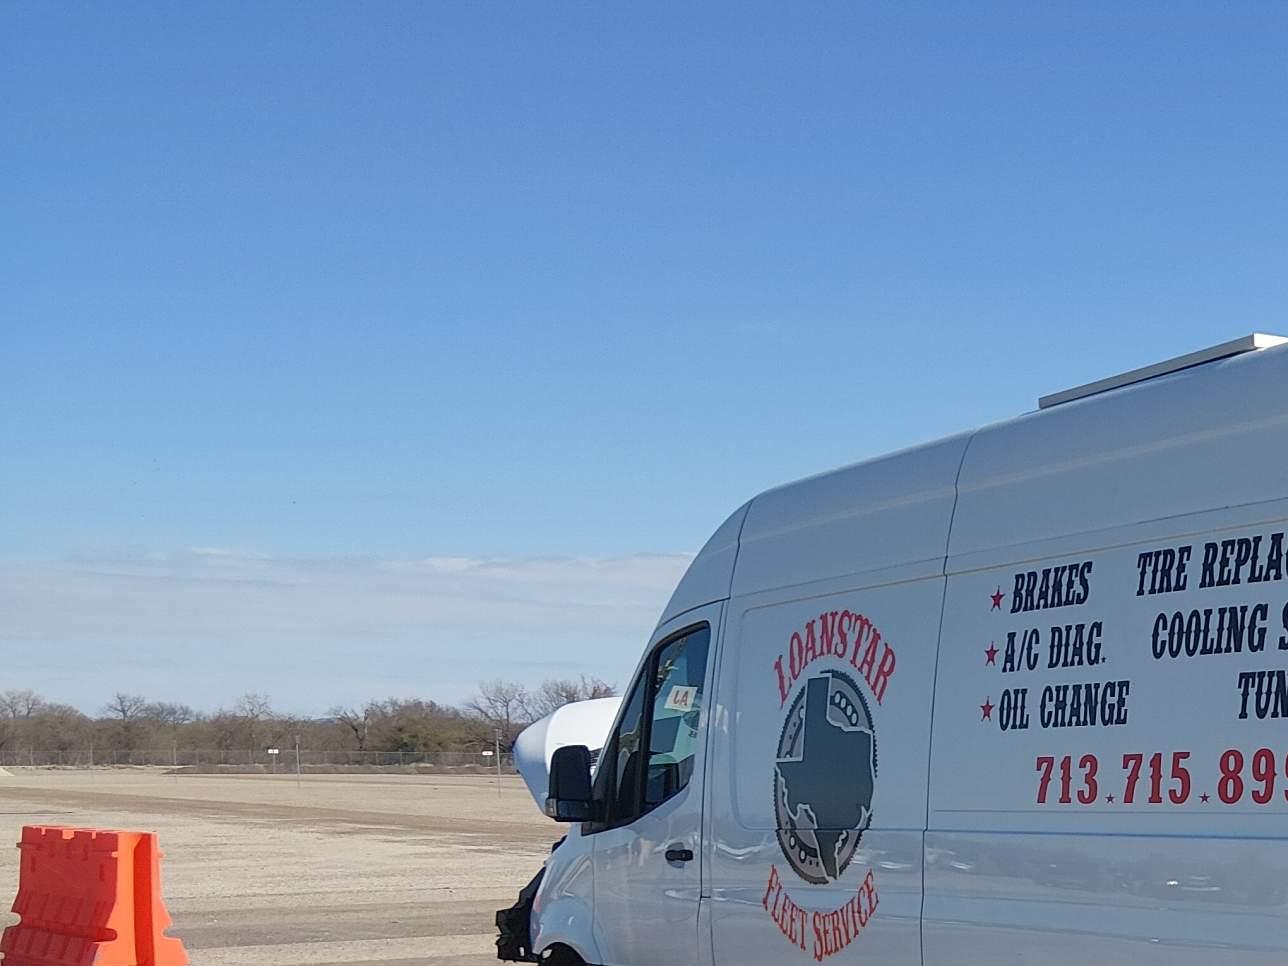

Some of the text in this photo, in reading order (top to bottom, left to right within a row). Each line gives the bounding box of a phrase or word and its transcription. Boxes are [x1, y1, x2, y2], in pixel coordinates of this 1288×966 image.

[1009, 561, 1093, 614] BRAKES
[1136, 545, 1192, 597] TIRE
[1002, 628, 1041, 673] A/C
[1151, 604, 1269, 660] COOLING
[773, 609, 897, 709] LOANSTAR
[998, 680, 1130, 732] OIL CHANGE
[762, 864, 880, 962] FLEET SERVICE
